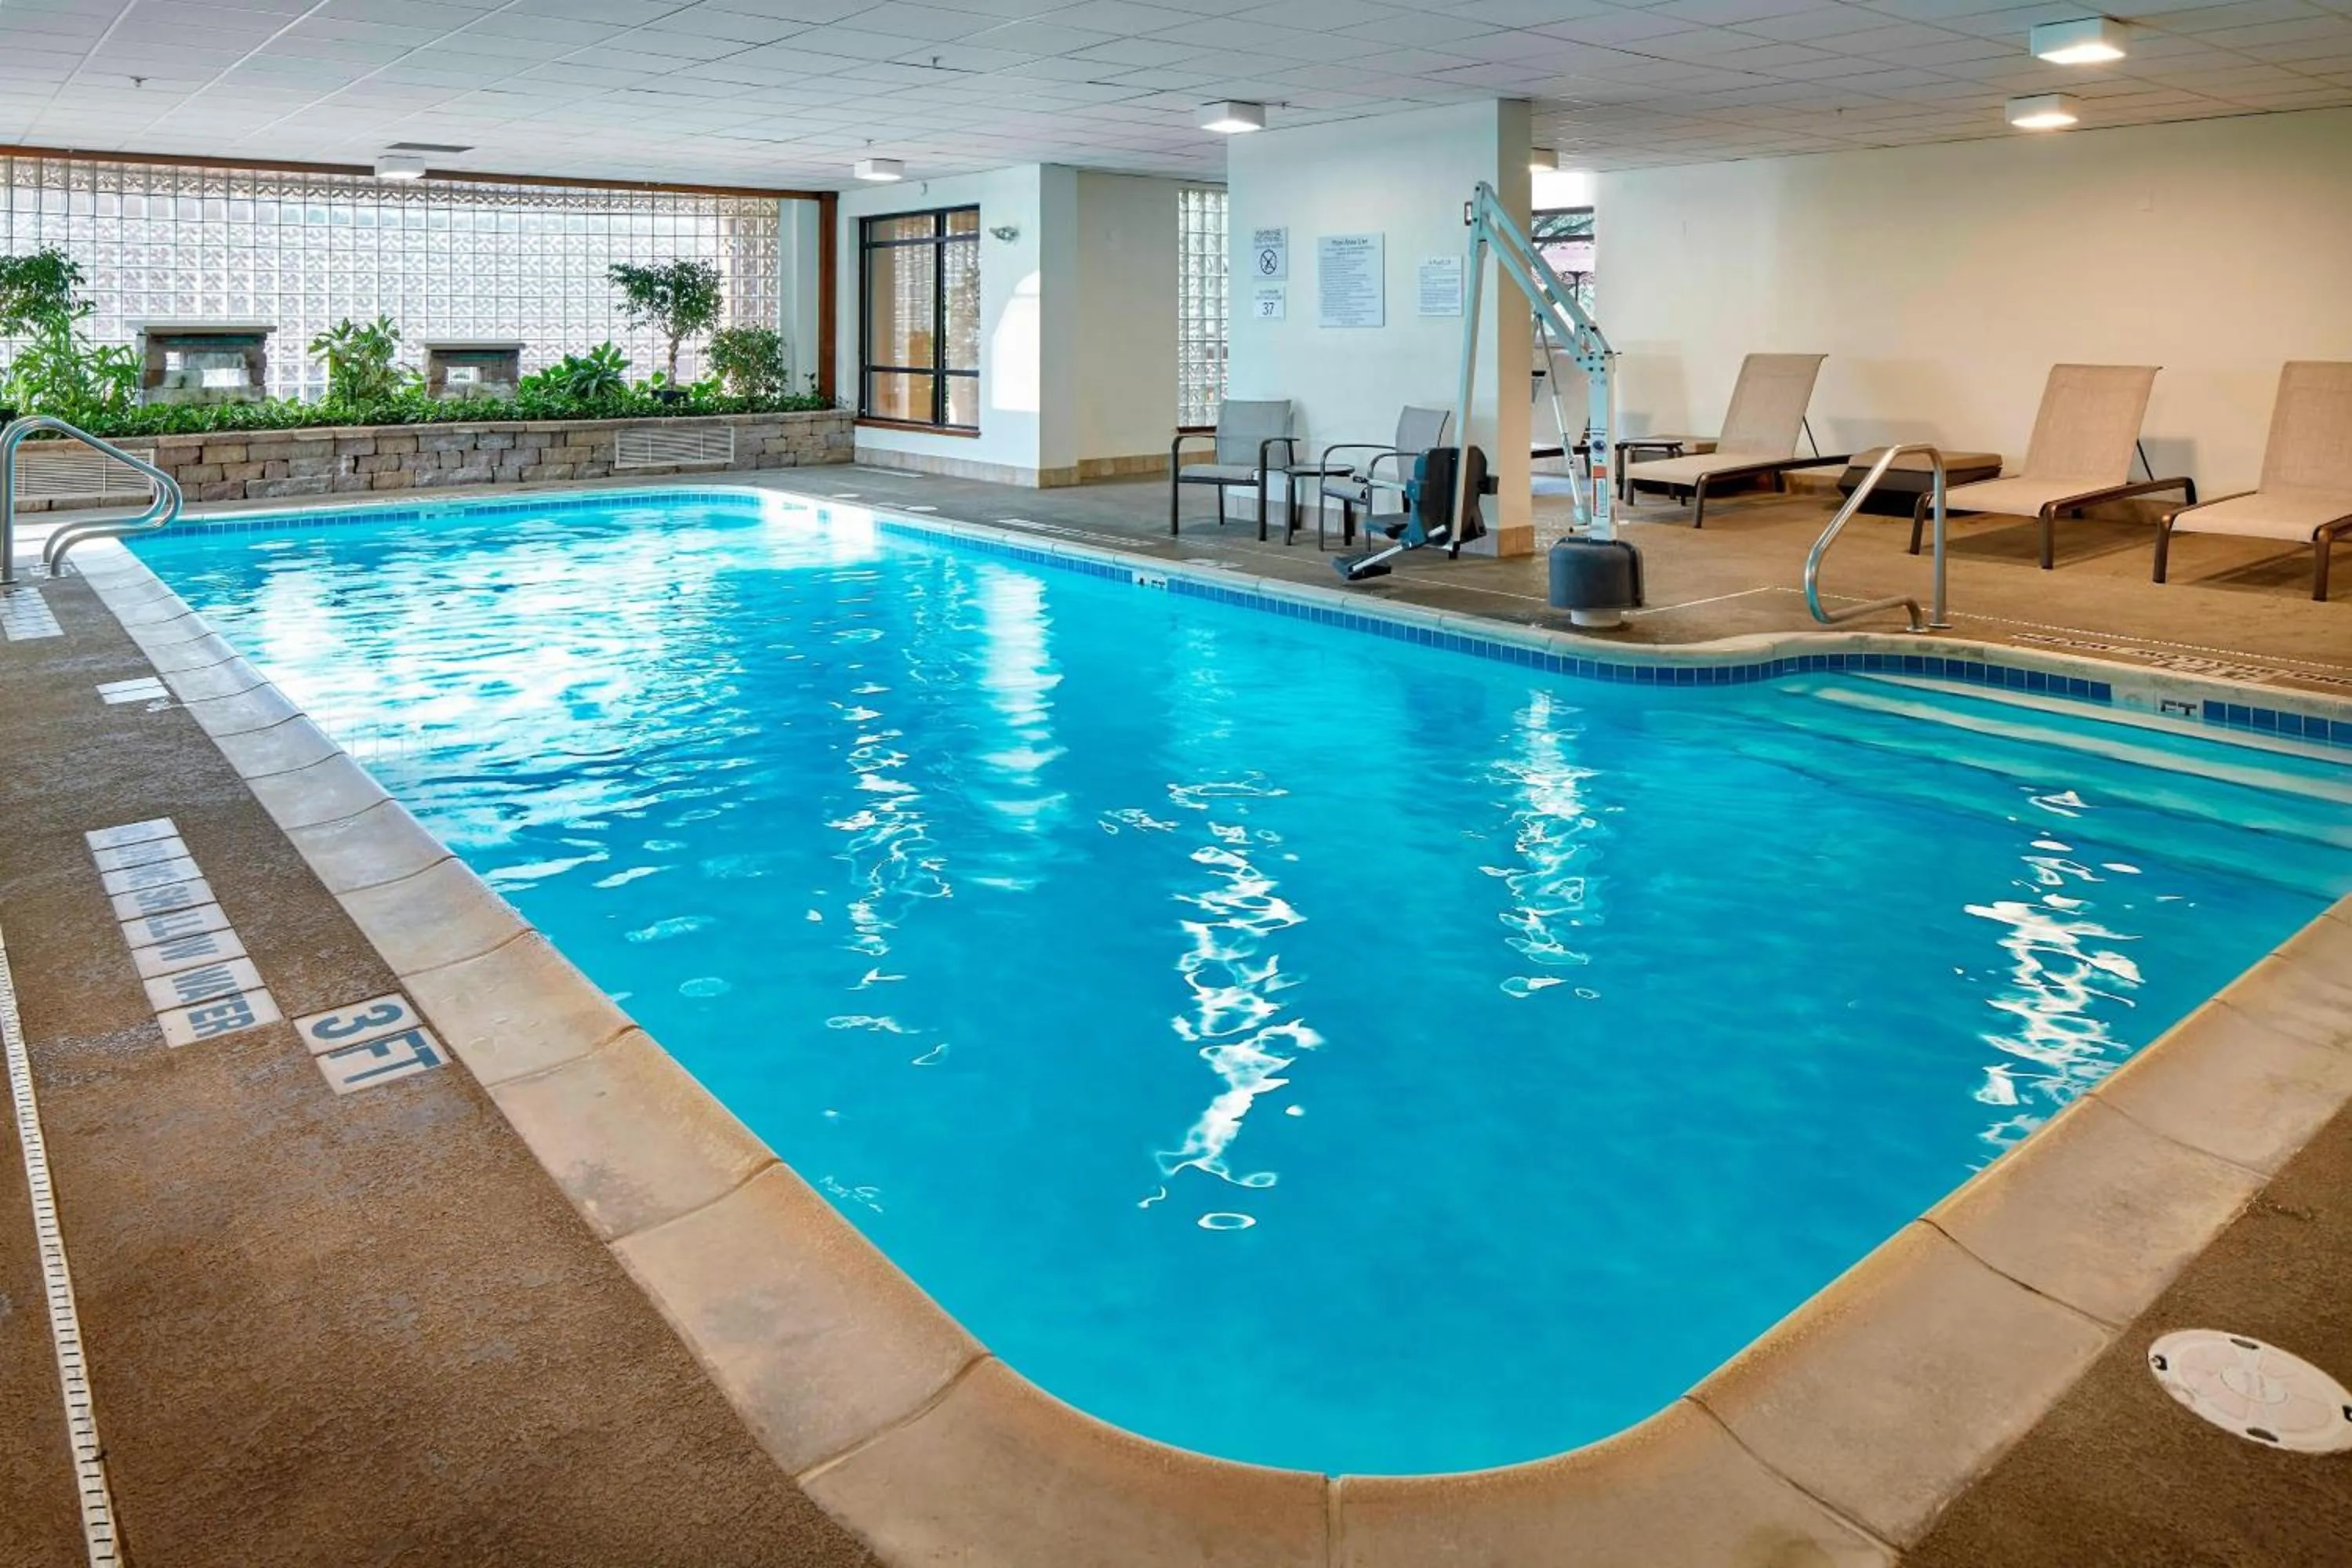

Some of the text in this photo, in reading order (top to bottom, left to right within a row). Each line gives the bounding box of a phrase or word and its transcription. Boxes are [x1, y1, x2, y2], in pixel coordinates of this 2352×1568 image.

[1262, 302, 1275, 315] 37
[135, 884, 220, 962] SHALLOW
[172, 964, 256, 1039] WATER
[311, 1004, 441, 1083] 3 FT
